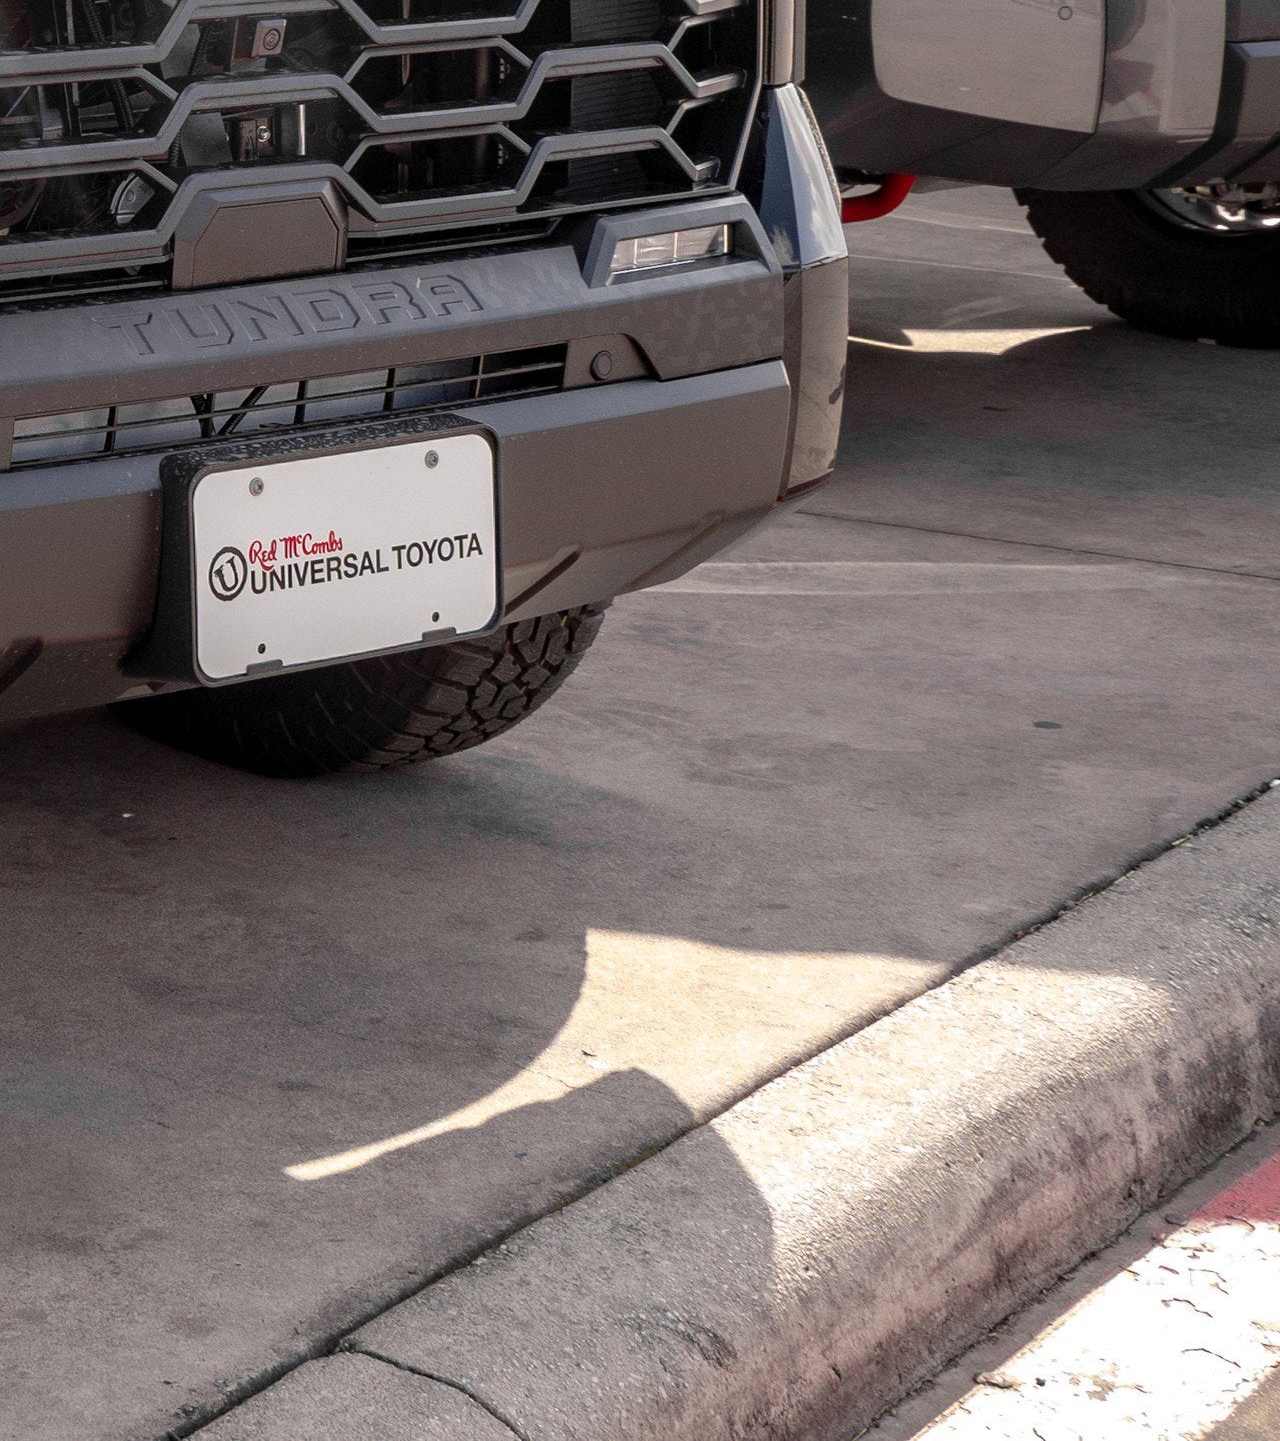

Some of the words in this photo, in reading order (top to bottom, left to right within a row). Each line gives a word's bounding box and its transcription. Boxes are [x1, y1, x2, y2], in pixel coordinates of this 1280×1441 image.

[92, 273, 484, 356] TUNDRA
[248, 539, 277, 571] Red
[279, 529, 343, 560] McCombs
[249, 549, 390, 595] UNIVERSAL
[391, 532, 484, 569] TOYOTA
